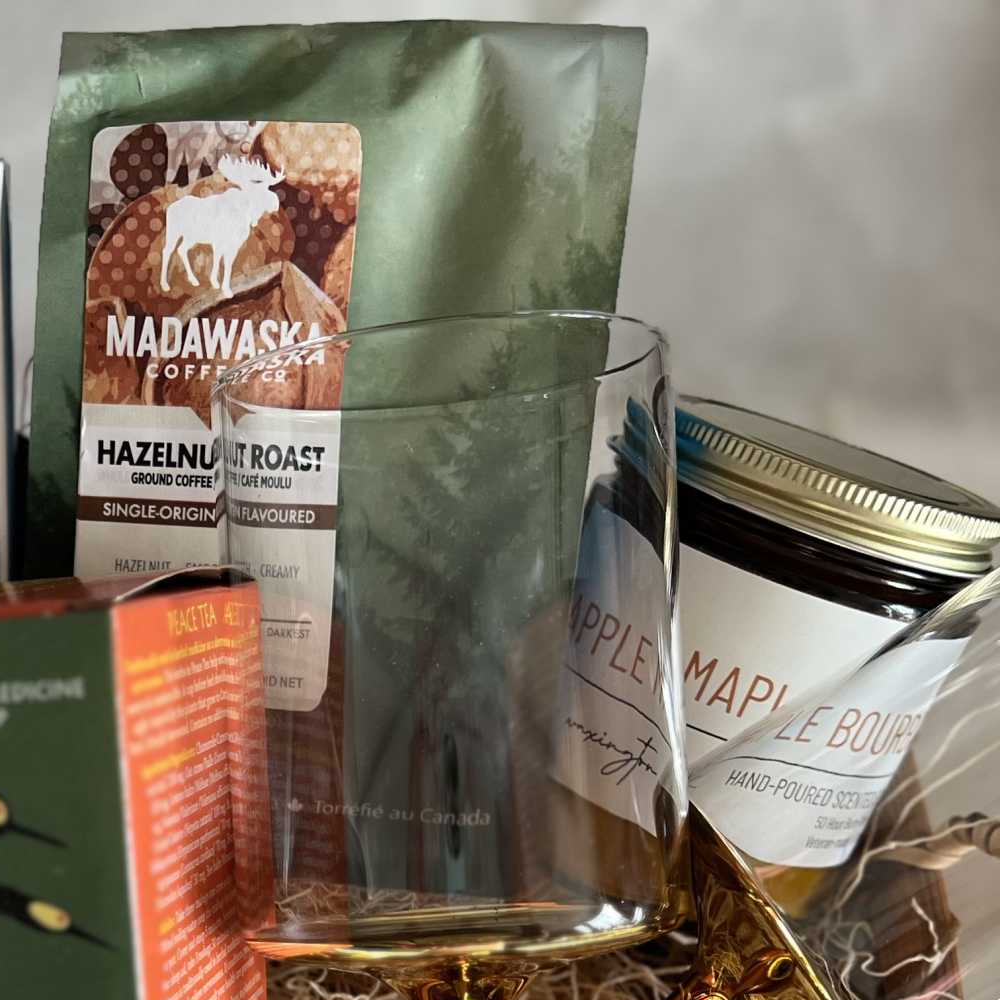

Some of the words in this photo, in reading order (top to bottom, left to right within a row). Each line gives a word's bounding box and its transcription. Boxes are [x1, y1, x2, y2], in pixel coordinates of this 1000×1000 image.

[106, 315, 325, 361] MADAWASKA
[251, 444, 325, 472] ROAST
[131, 472, 173, 486] GROUND
[175, 474, 213, 488] COFFEE
[241, 473, 259, 488] CAFÉ
[260, 476, 292, 489] MOULU
[103, 502, 217, 522] SINGLE-ORIGIN
[241, 507, 316, 524] FLAVOURED
[260, 564, 301, 578] CREAMY
[197, 602, 217, 628] TEA
[280, 677, 304, 689] NET
[826, 707, 923, 756] BOUR
[725, 769, 833, 808] HAND-POURED
[420, 807, 491, 827] Canada
